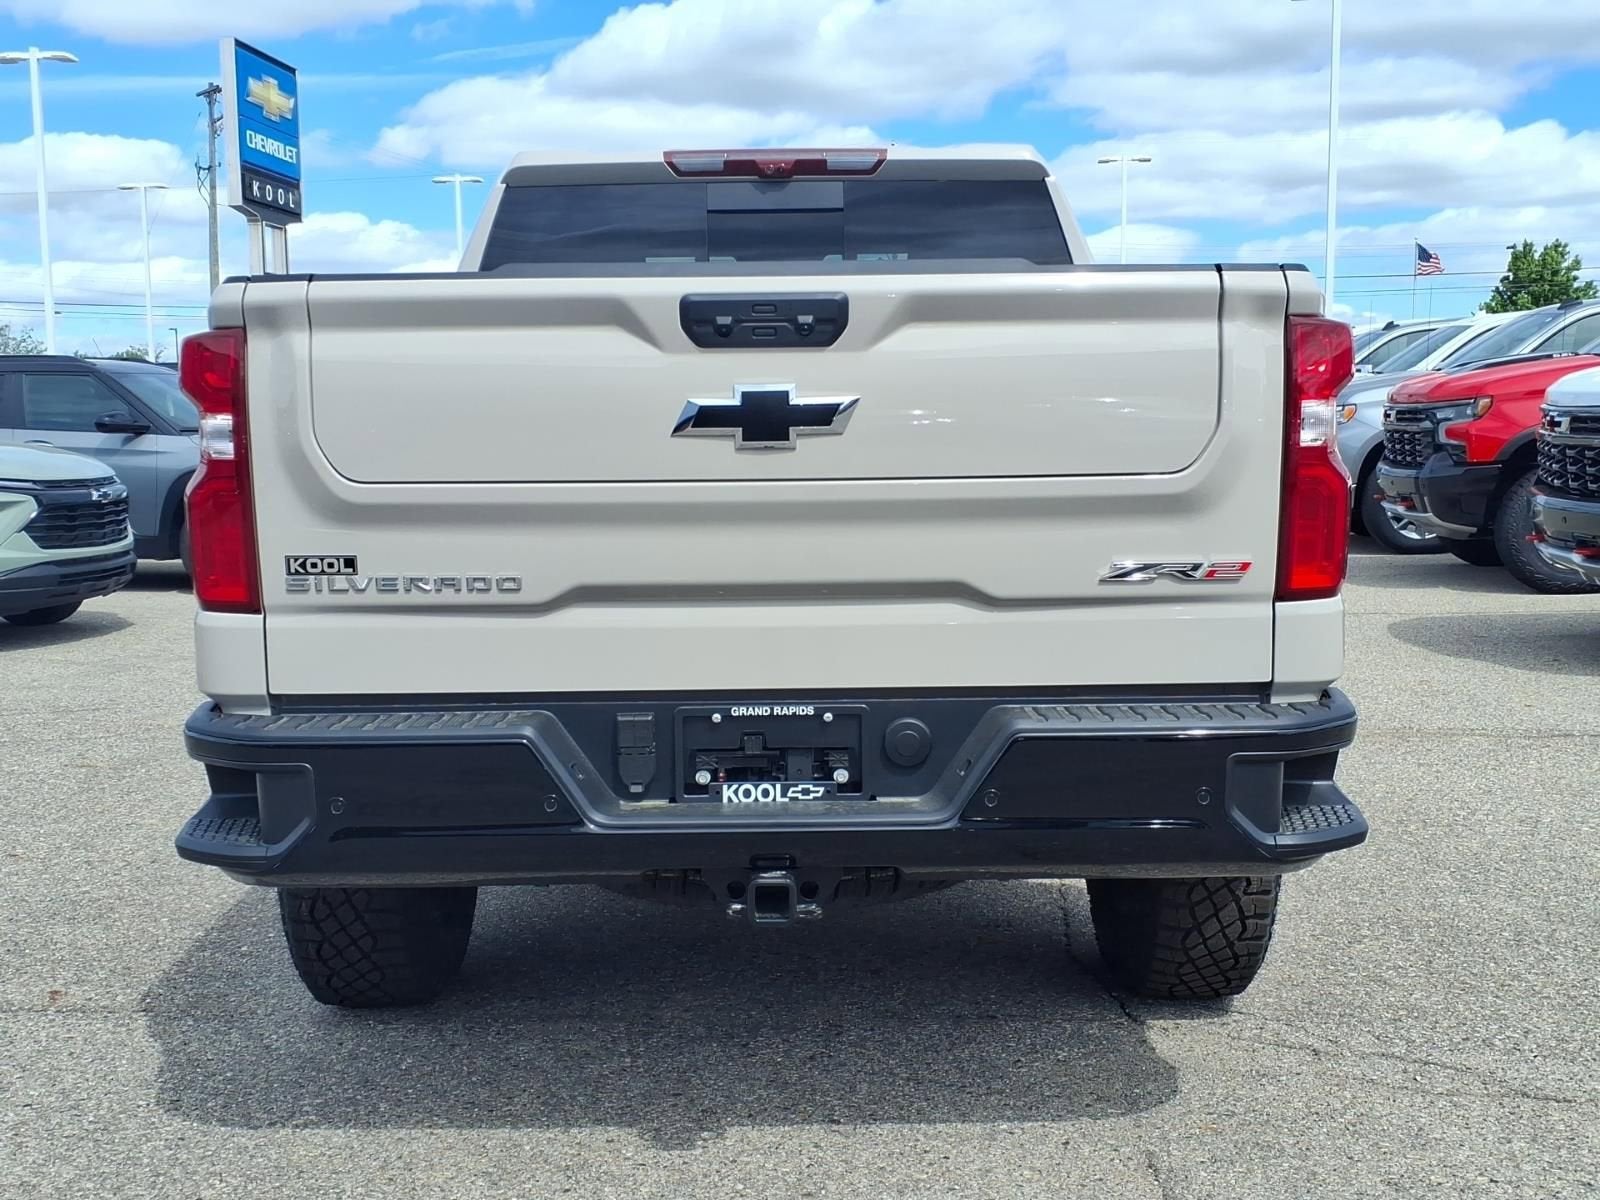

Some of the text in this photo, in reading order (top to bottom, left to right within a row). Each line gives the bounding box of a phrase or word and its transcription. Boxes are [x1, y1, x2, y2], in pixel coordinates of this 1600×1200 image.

[246, 130, 297, 163] CHEVROLET
[253, 181, 295, 208] KOOL
[289, 558, 353, 574] KOOL
[1102, 561, 1253, 582] ZR2
[286, 576, 522, 592] SILVERADO
[731, 706, 815, 716] GRAND RAPIDS
[722, 784, 789, 803] KOOL
